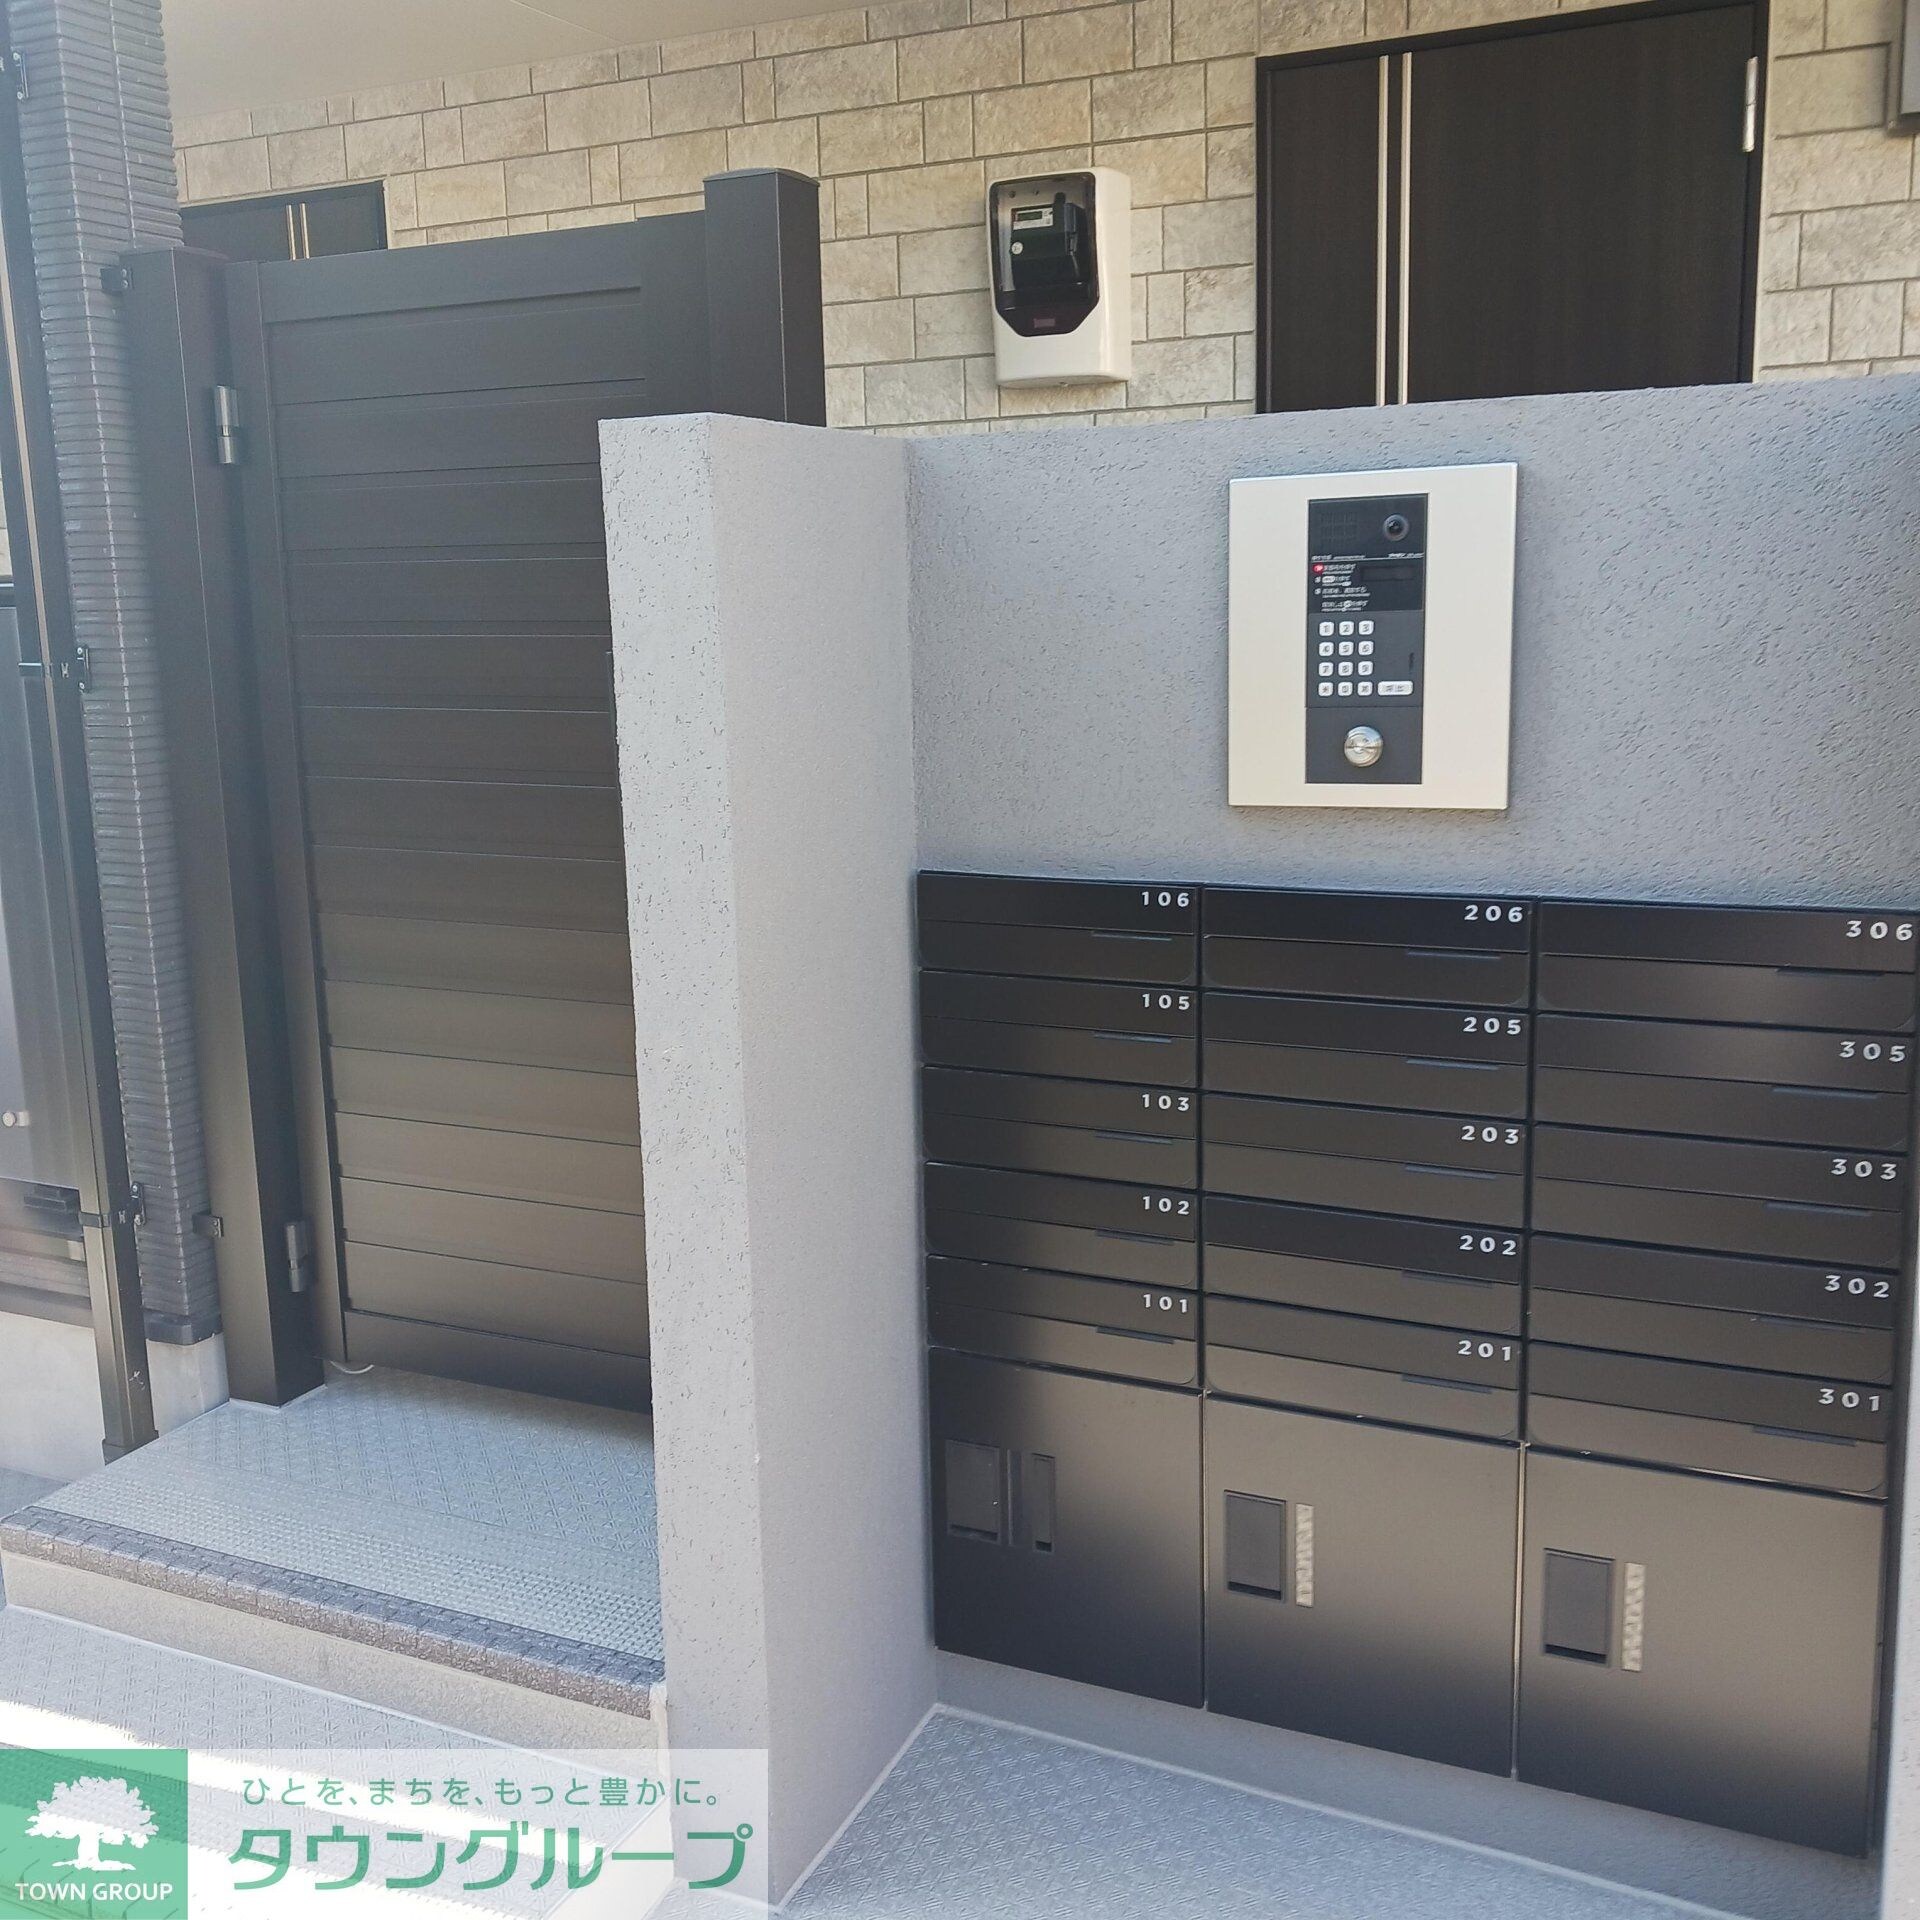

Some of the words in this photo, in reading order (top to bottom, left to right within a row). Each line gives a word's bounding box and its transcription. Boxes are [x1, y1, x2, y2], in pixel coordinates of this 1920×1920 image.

[1141, 890, 1190, 908] 106
[1464, 904, 1524, 923] 206
[1845, 920, 1914, 941] 306
[1142, 993, 1190, 1011] 105
[1462, 1016, 1522, 1035] 205
[1839, 1040, 1906, 1063] 305
[1141, 1093, 1190, 1112] 103
[1461, 1125, 1520, 1145] 203
[1830, 1158, 1898, 1180] 303
[1142, 1195, 1190, 1216] 102
[1459, 1234, 1518, 1256] 202
[1824, 1274, 1890, 1298] 302
[1142, 1293, 1189, 1314] 101
[1457, 1339, 1513, 1362] 201
[1818, 1387, 1881, 1412] 301
